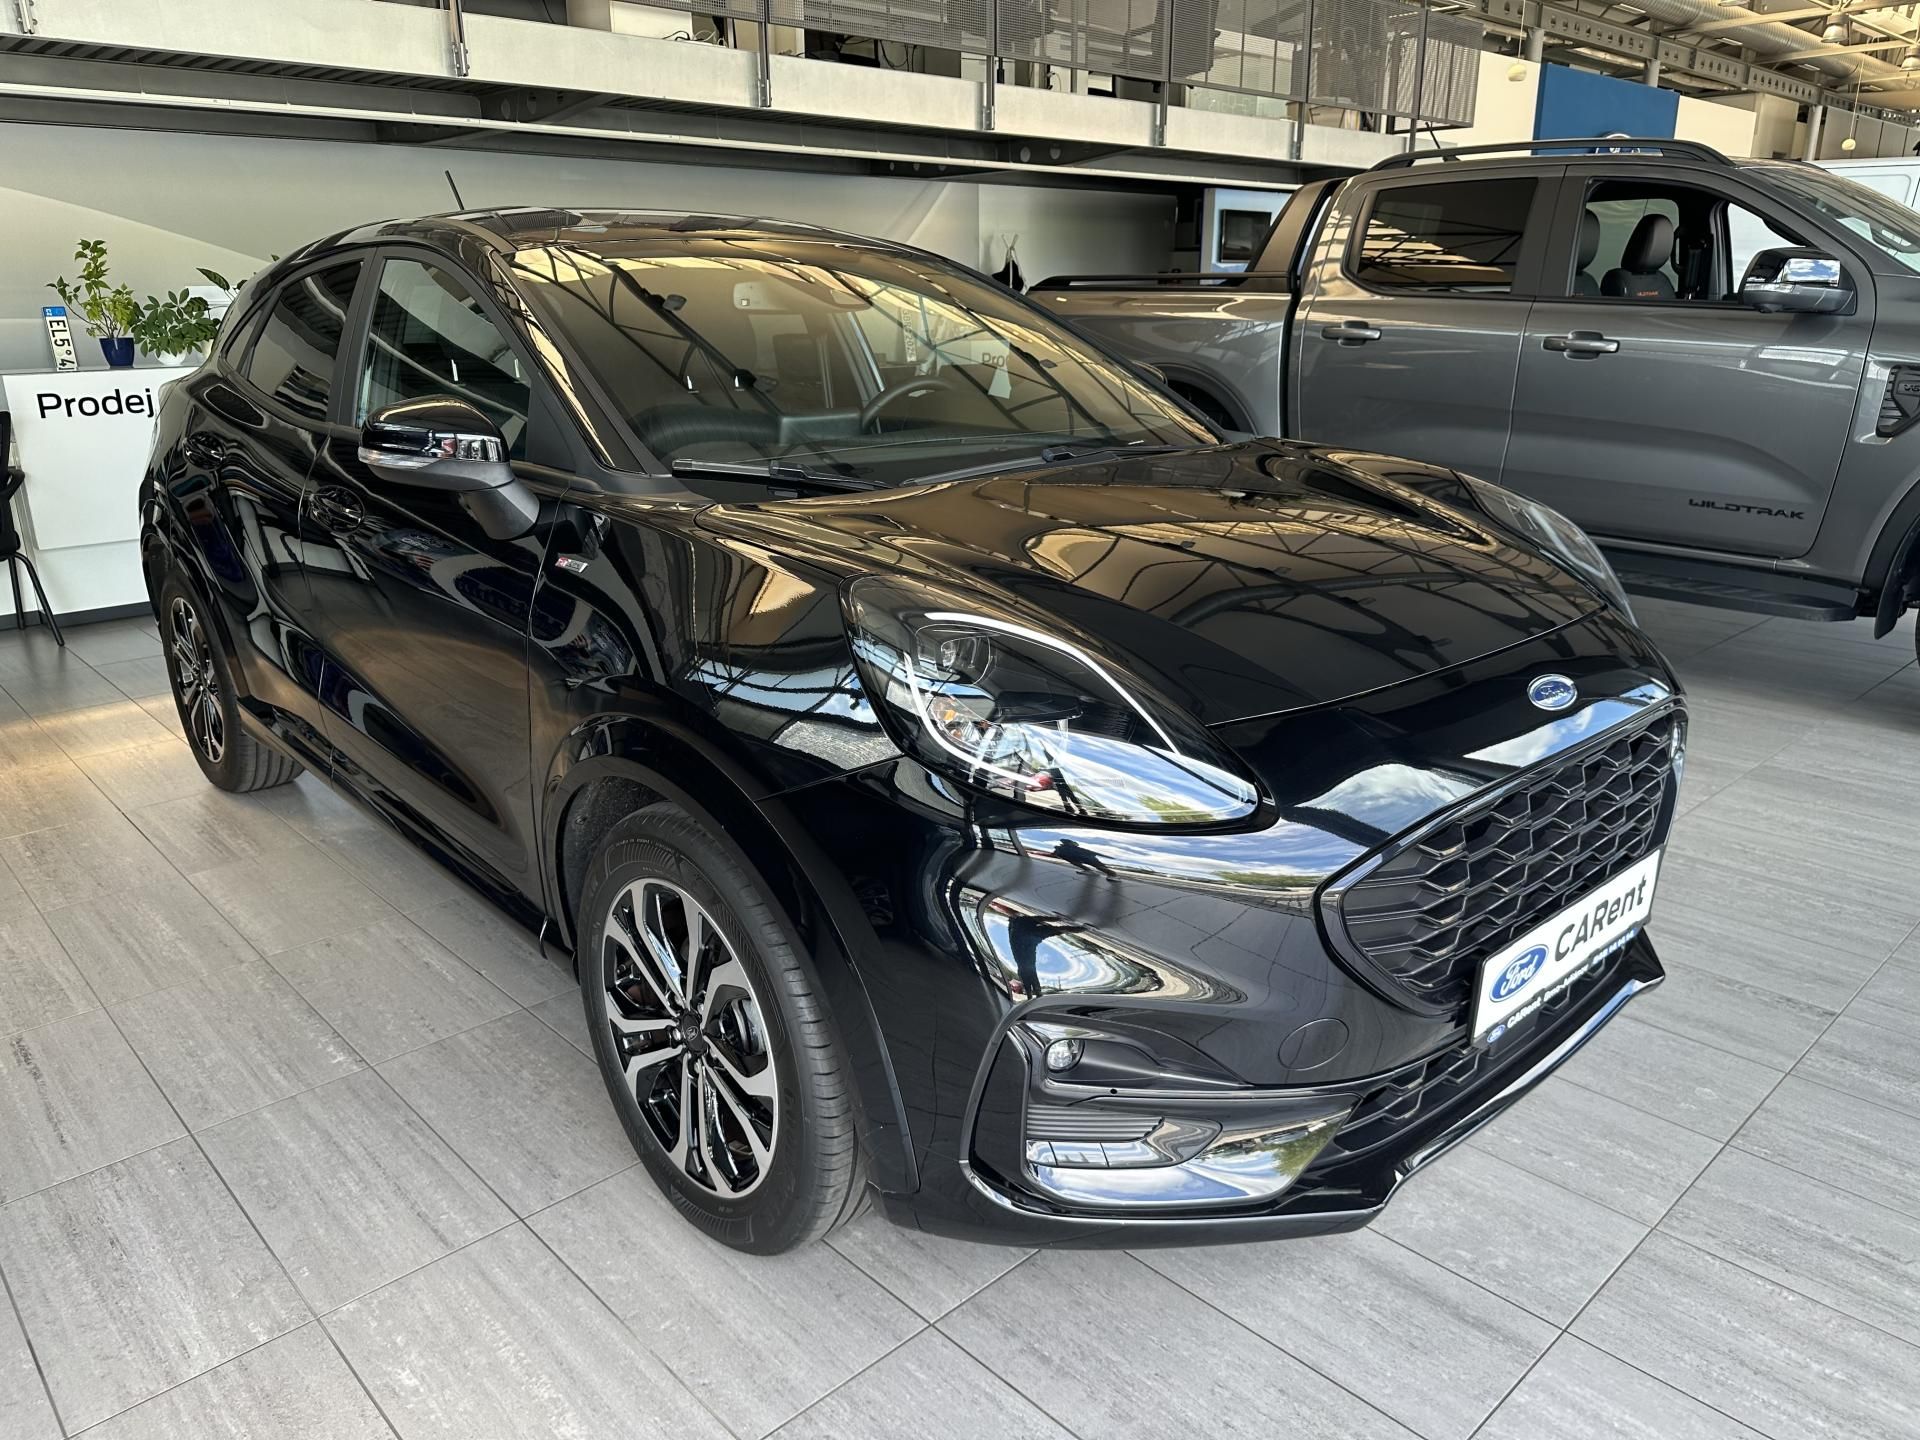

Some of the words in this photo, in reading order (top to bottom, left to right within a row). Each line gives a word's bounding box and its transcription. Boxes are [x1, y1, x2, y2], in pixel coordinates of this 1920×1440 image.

[36, 388, 155, 418] Prodej
[1688, 498, 1806, 520] WILDTRAK
[1554, 875, 1647, 962] CARent
